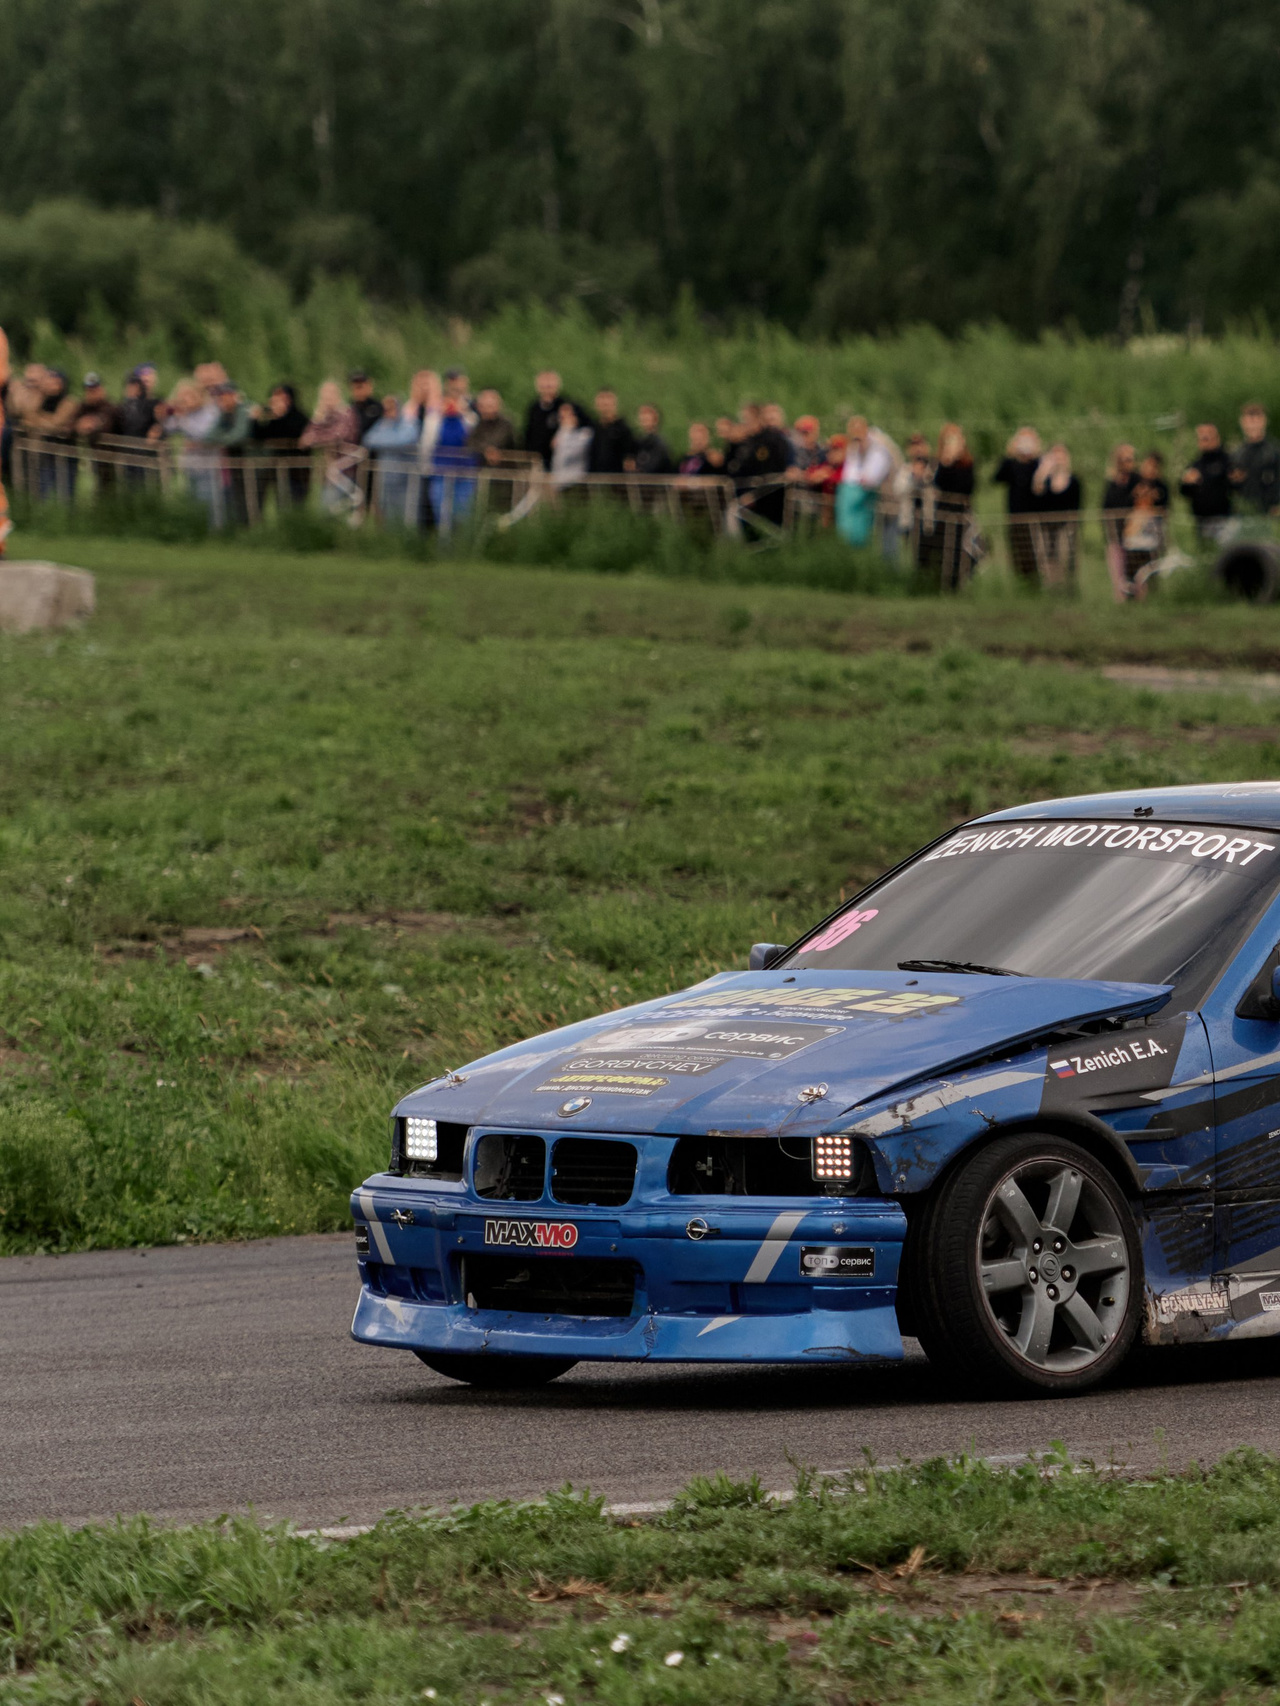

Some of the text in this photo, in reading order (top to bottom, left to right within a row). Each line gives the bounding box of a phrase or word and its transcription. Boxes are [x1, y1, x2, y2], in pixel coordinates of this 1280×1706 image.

[923, 824, 1276, 867] ZENICH MOTORSPORT
[797, 909, 879, 954] 36
[842, 992, 960, 1014] 22
[704, 1030, 805, 1046] сервис
[1070, 1038, 1168, 1074] Zenich E.A.
[484, 1220, 579, 1249] MAXMO
[808, 1256, 872, 1267] ТОП сервис
